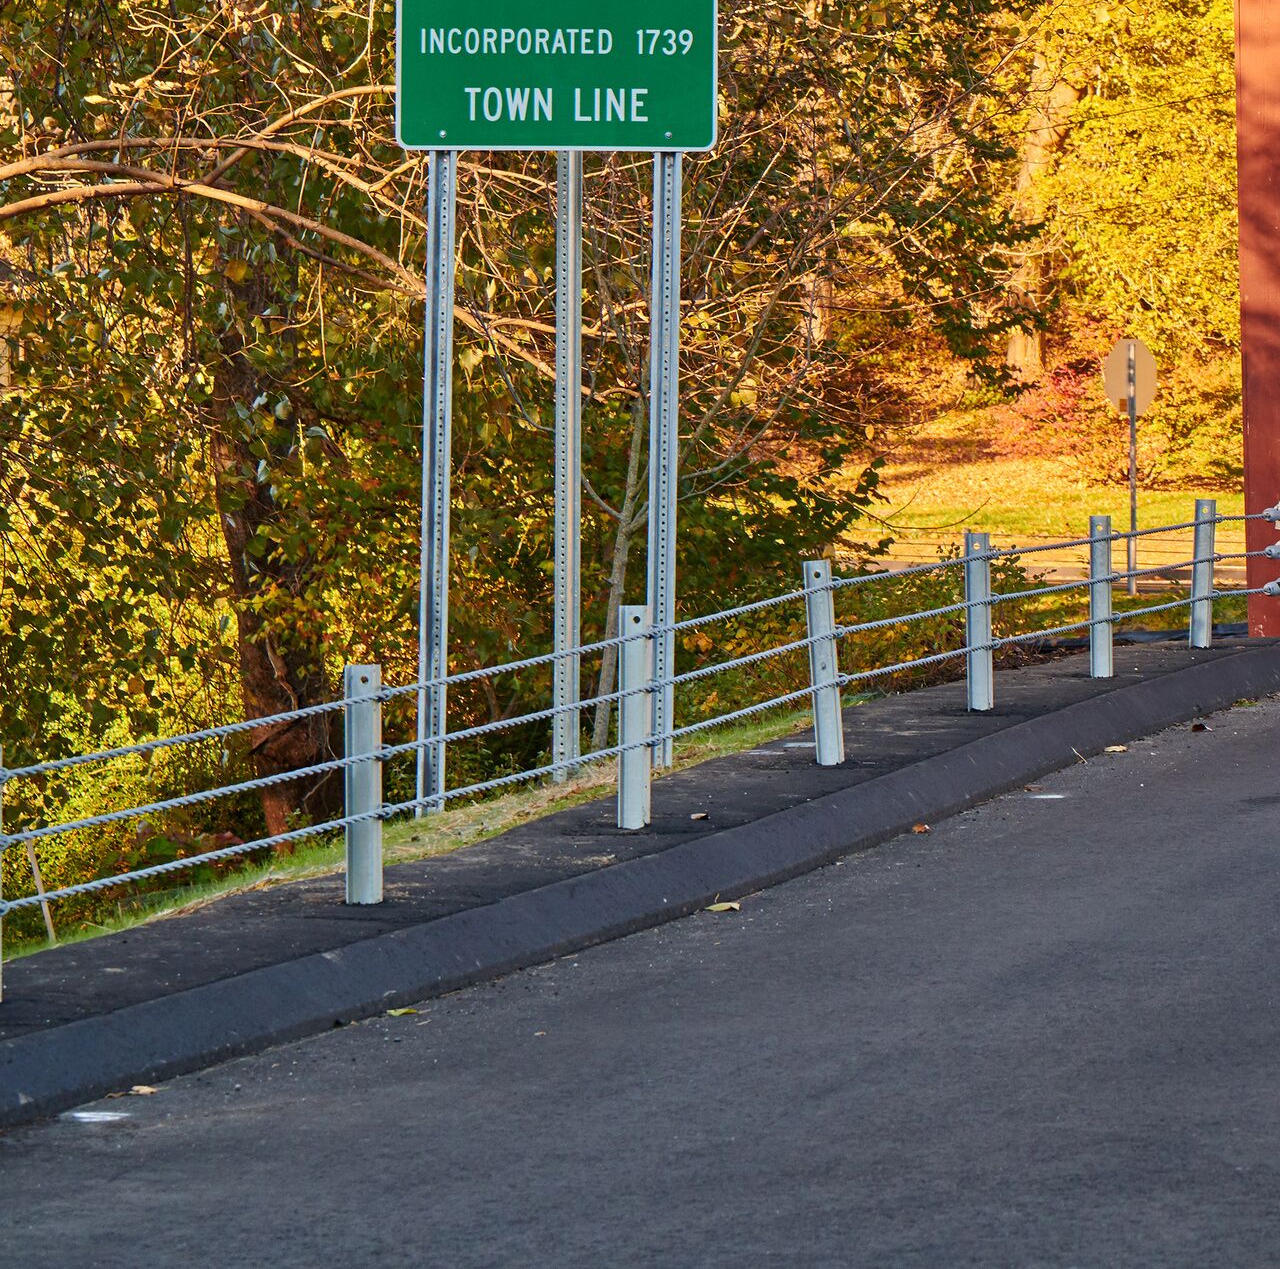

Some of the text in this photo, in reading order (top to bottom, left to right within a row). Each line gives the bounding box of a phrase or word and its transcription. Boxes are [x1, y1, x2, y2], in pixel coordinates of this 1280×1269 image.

[420, 28, 694, 56] INCORPORATED 1739
[465, 87, 649, 122] TOWN LINE
